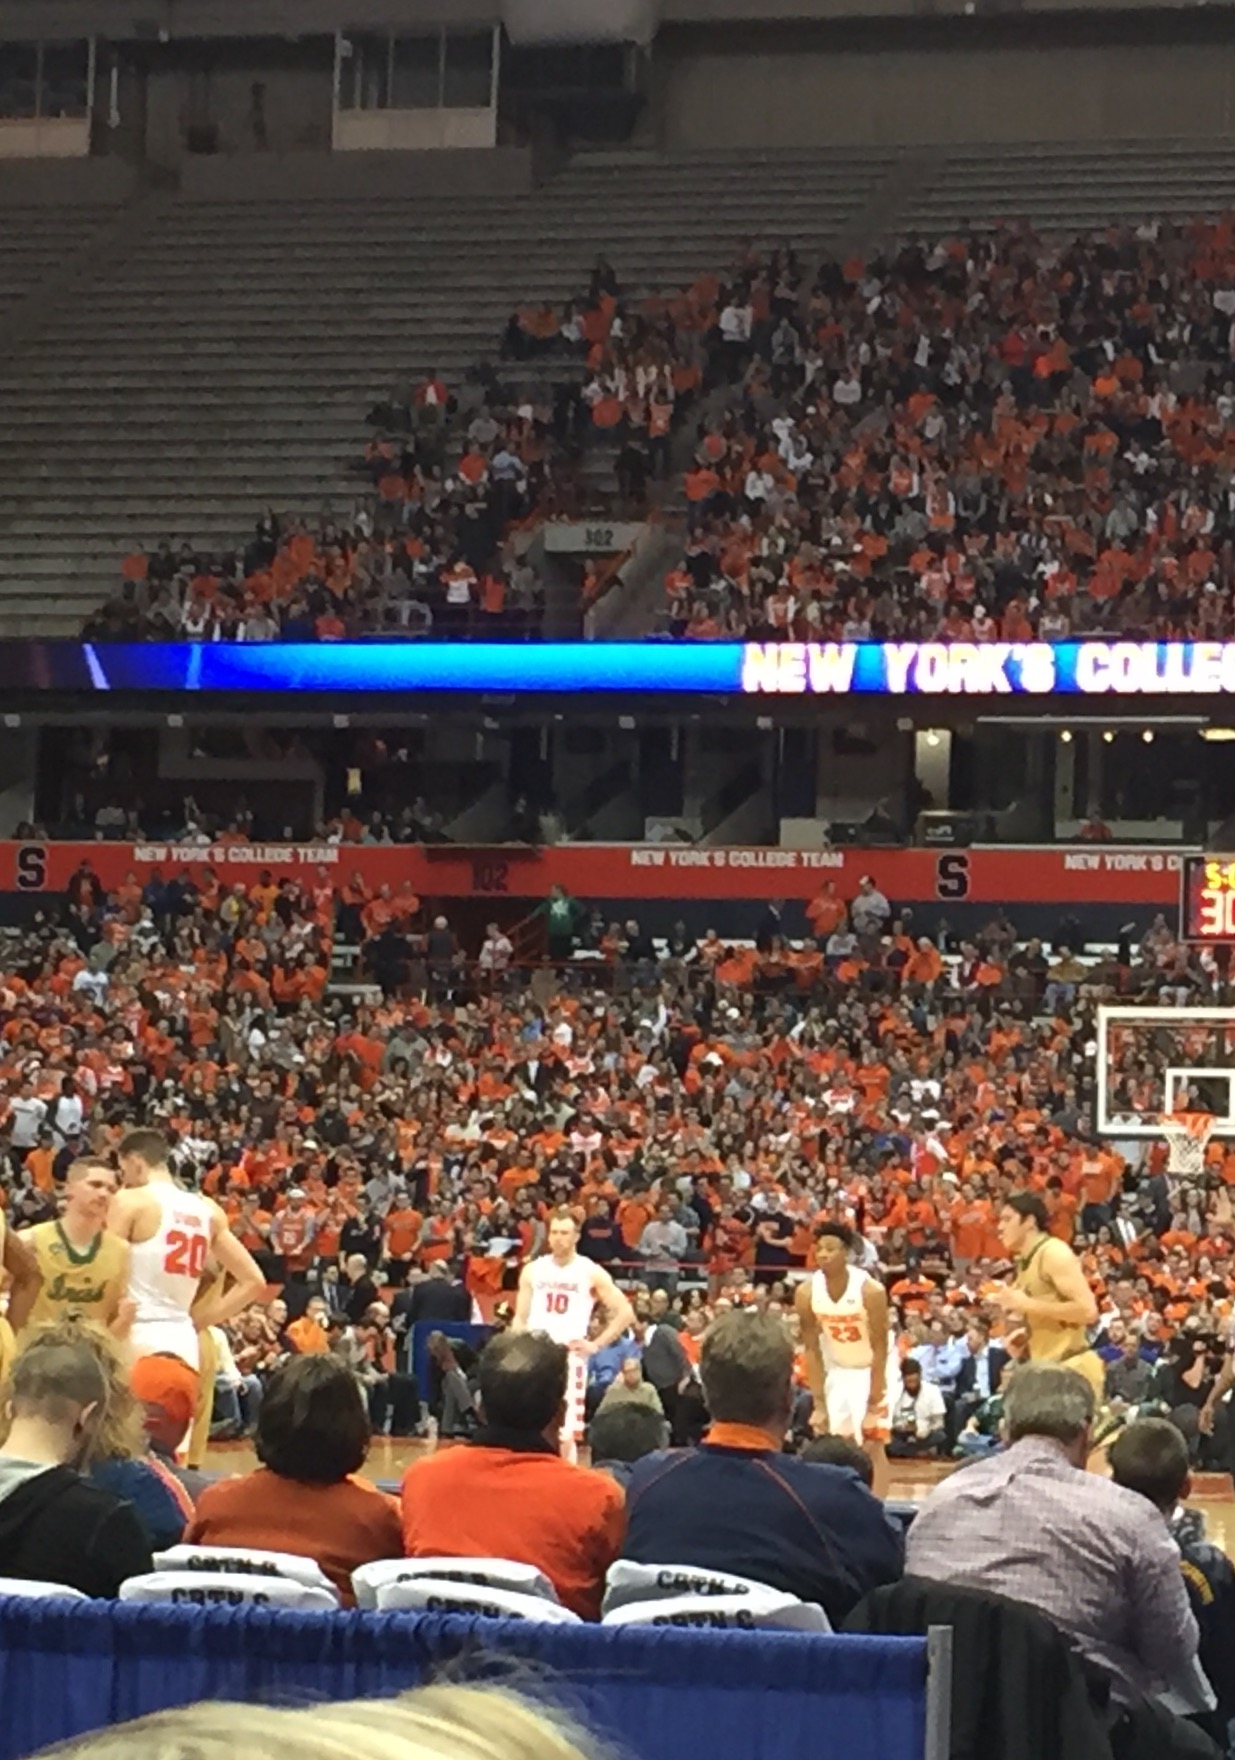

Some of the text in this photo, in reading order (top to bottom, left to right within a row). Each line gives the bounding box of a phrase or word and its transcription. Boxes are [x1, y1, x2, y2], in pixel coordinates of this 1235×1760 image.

[743, 642, 857, 692] NEW
[885, 642, 1055, 692] YORK'S
[134, 847, 339, 863] NEW YORK'S COLLEGE TEAM
[631, 850, 844, 867] NEW YORK'S COLLEGE TEAM
[1064, 854, 1100, 870] NEW
[1105, 854, 1163, 871] YORK'S
[164, 1229, 208, 1279] 20
[546, 1292, 569, 1314] 10
[828, 1326, 862, 1343] 23
